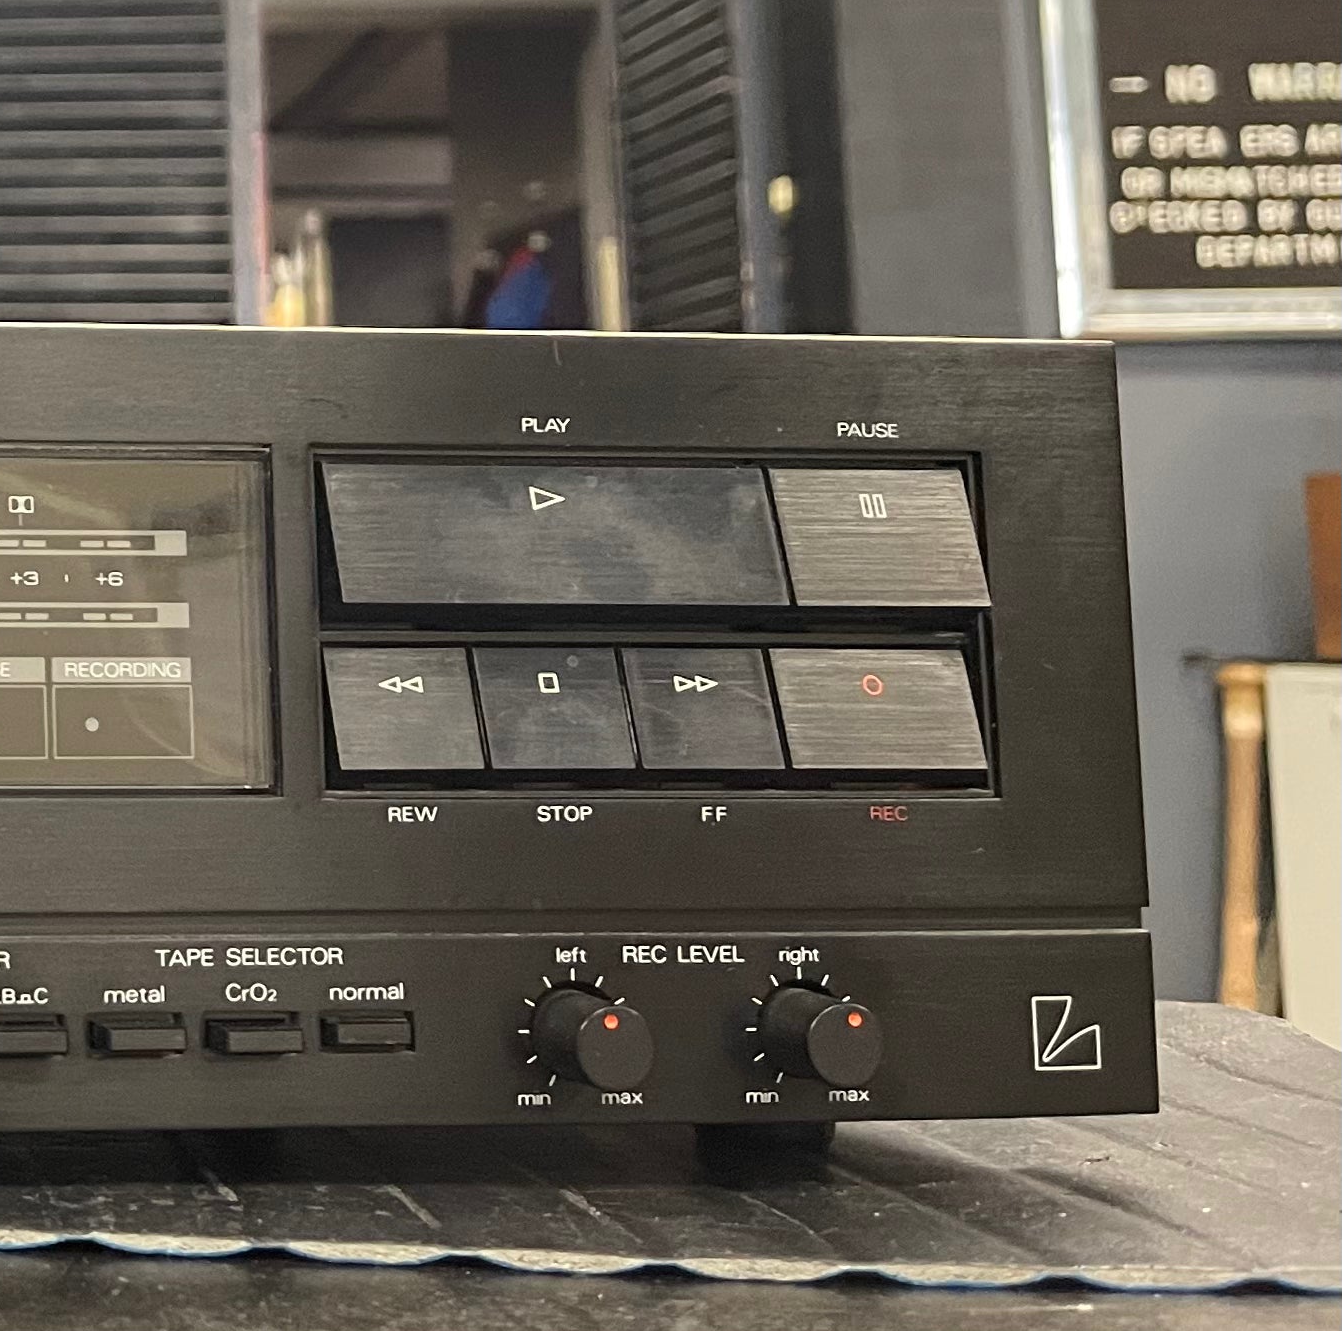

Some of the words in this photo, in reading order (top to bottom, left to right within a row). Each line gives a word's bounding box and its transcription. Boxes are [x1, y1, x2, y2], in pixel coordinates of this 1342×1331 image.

[1165, 63, 1217, 104] NO
[1112, 125, 1146, 160] IF
[521, 417, 571, 433] PLAY
[837, 421, 899, 439] PAUSE
[10, 570, 39, 586] +3
[95, 571, 124, 587] +6
[64, 661, 182, 679] RECORDING
[387, 806, 438, 823] REW
[536, 805, 593, 823] STOP
[701, 806, 727, 822] FF
[870, 805, 908, 822] REC
[154, 948, 215, 967] TAPE
[225, 946, 344, 967] SELECTOR
[555, 946, 587, 964] left
[622, 944, 667, 964] REC
[677, 945, 746, 964] LEVEL
[778, 946, 820, 966] right
[103, 985, 166, 1004] metal
[329, 982, 405, 1001] normal
[517, 1093, 552, 1106] min
[601, 1092, 644, 1105] max
[745, 1091, 779, 1104] min
[829, 1089, 870, 1102] max
